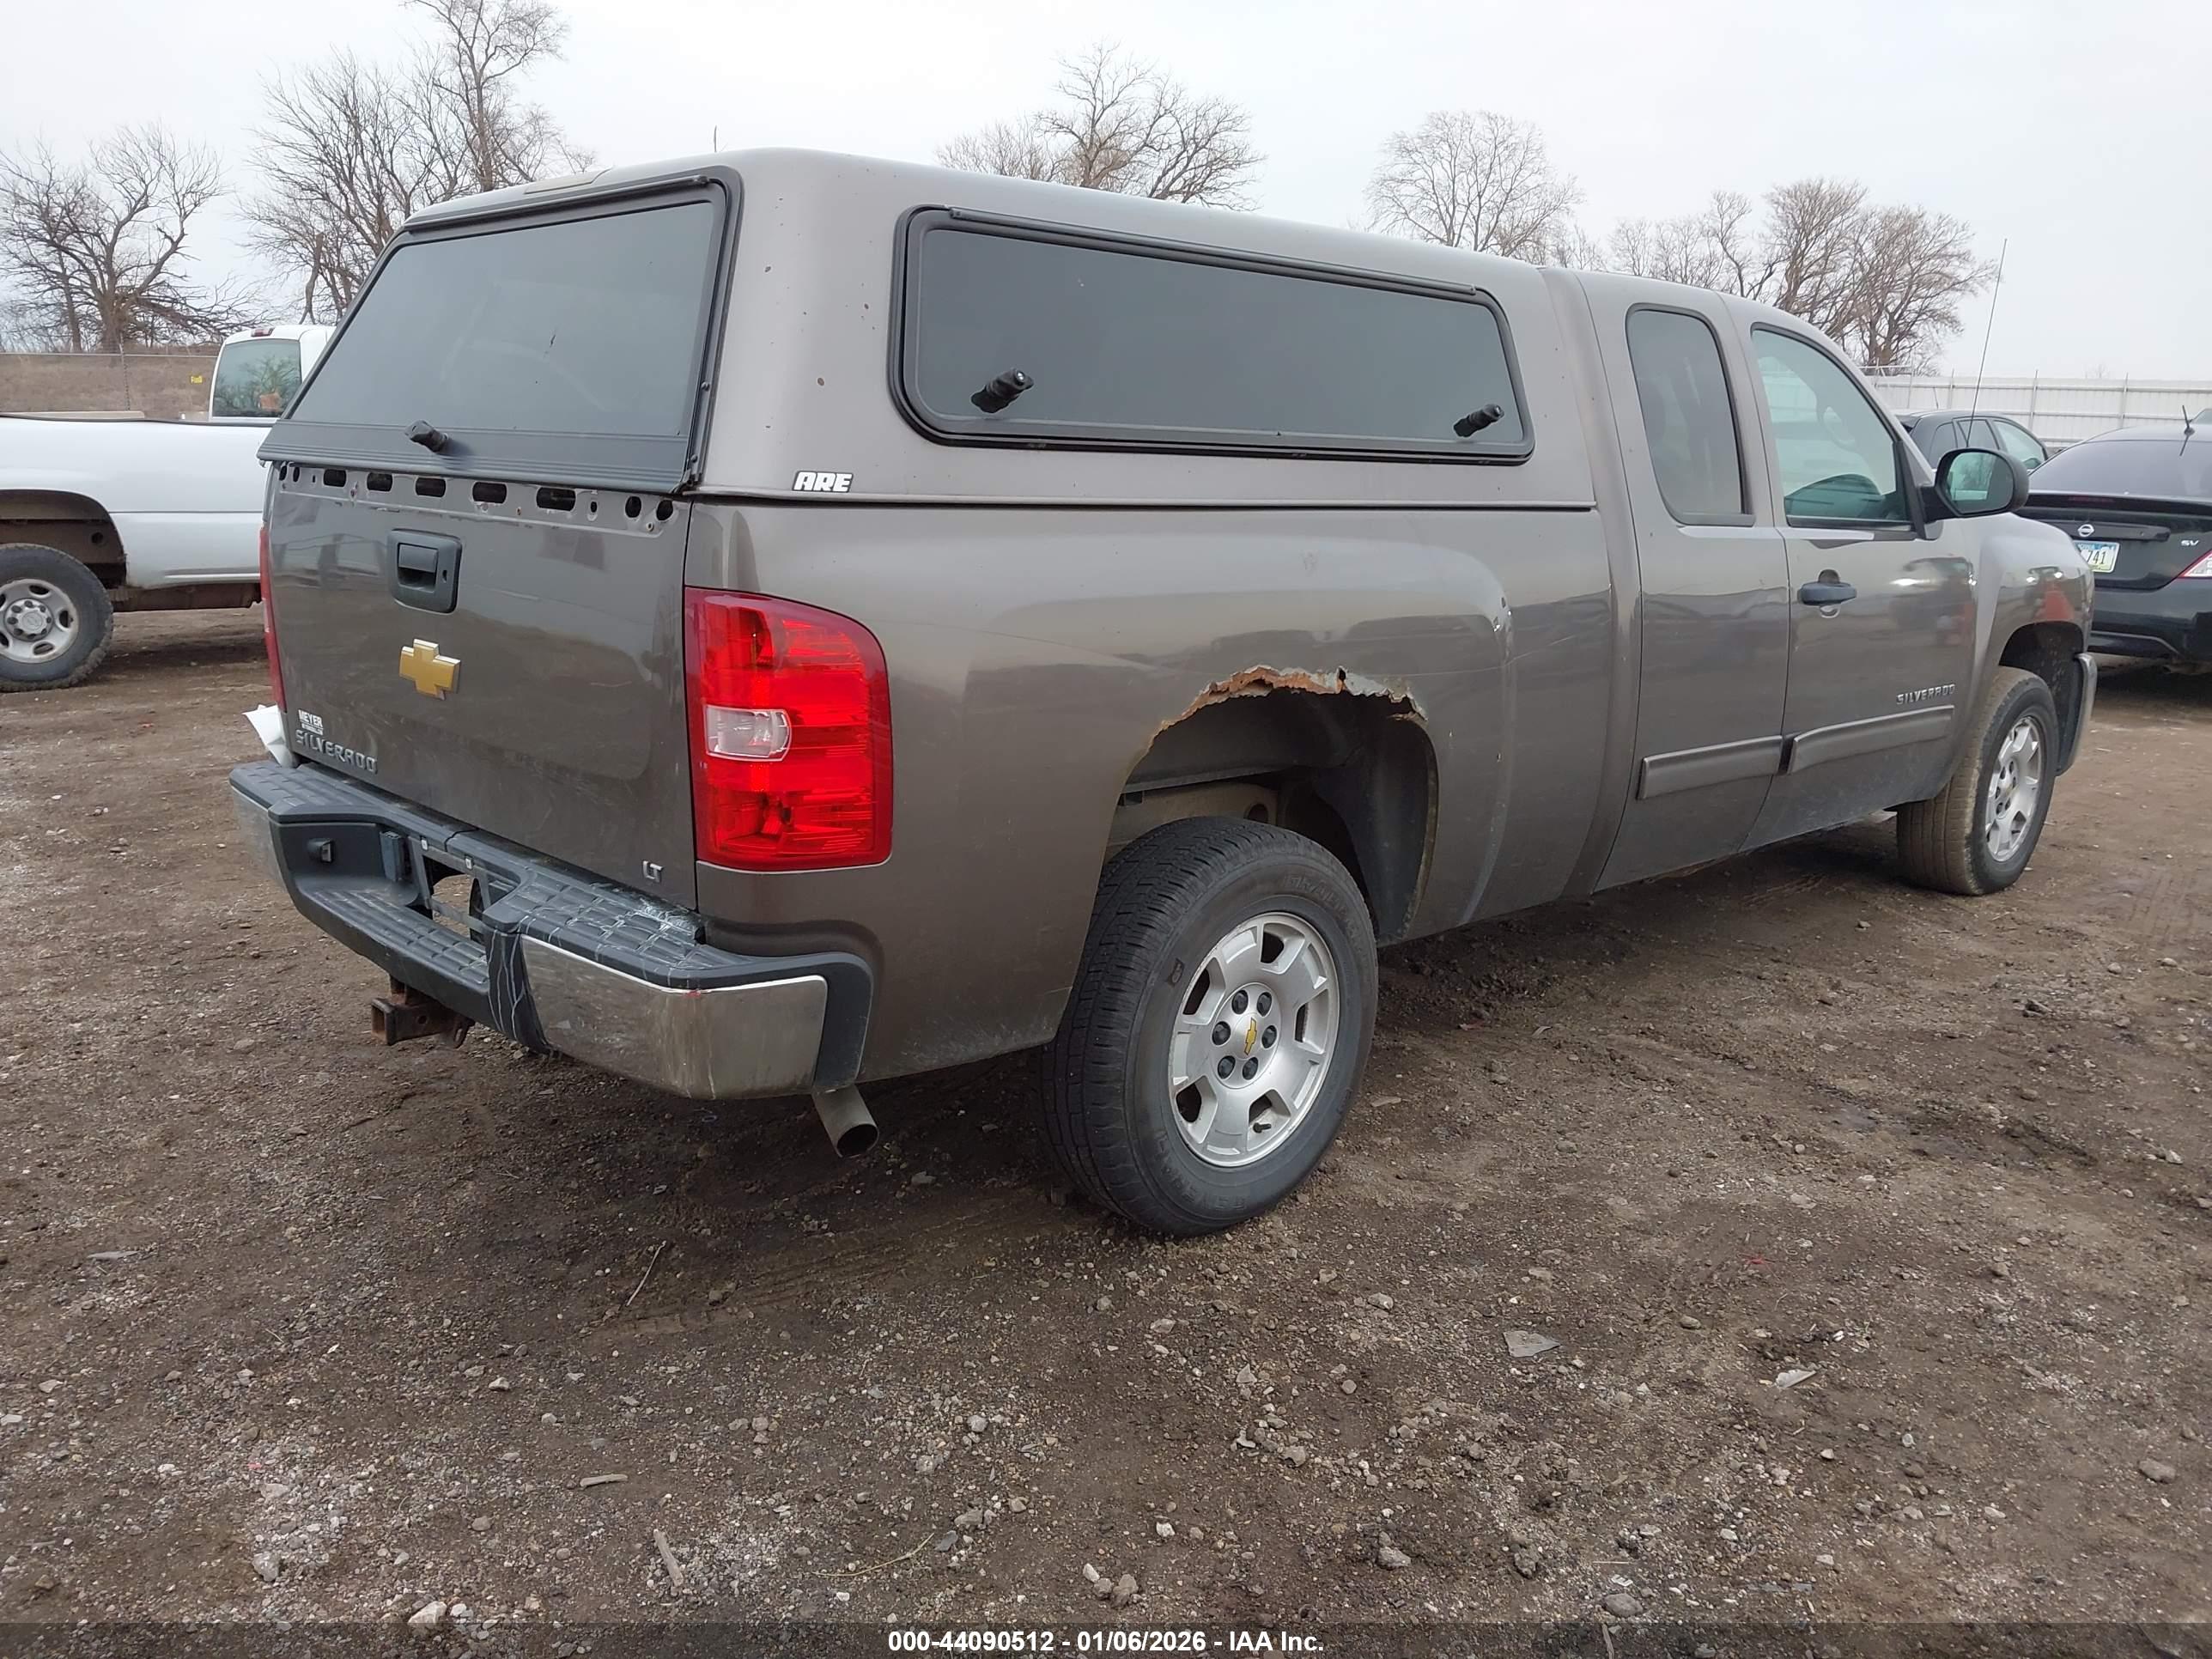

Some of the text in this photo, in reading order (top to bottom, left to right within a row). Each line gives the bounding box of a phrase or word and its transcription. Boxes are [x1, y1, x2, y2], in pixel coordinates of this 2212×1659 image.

[792, 471, 854, 493] ARE
[1896, 684, 1956, 705] SILVERADO
[295, 729, 378, 774] SILVERADO
[642, 860, 663, 883] LT
